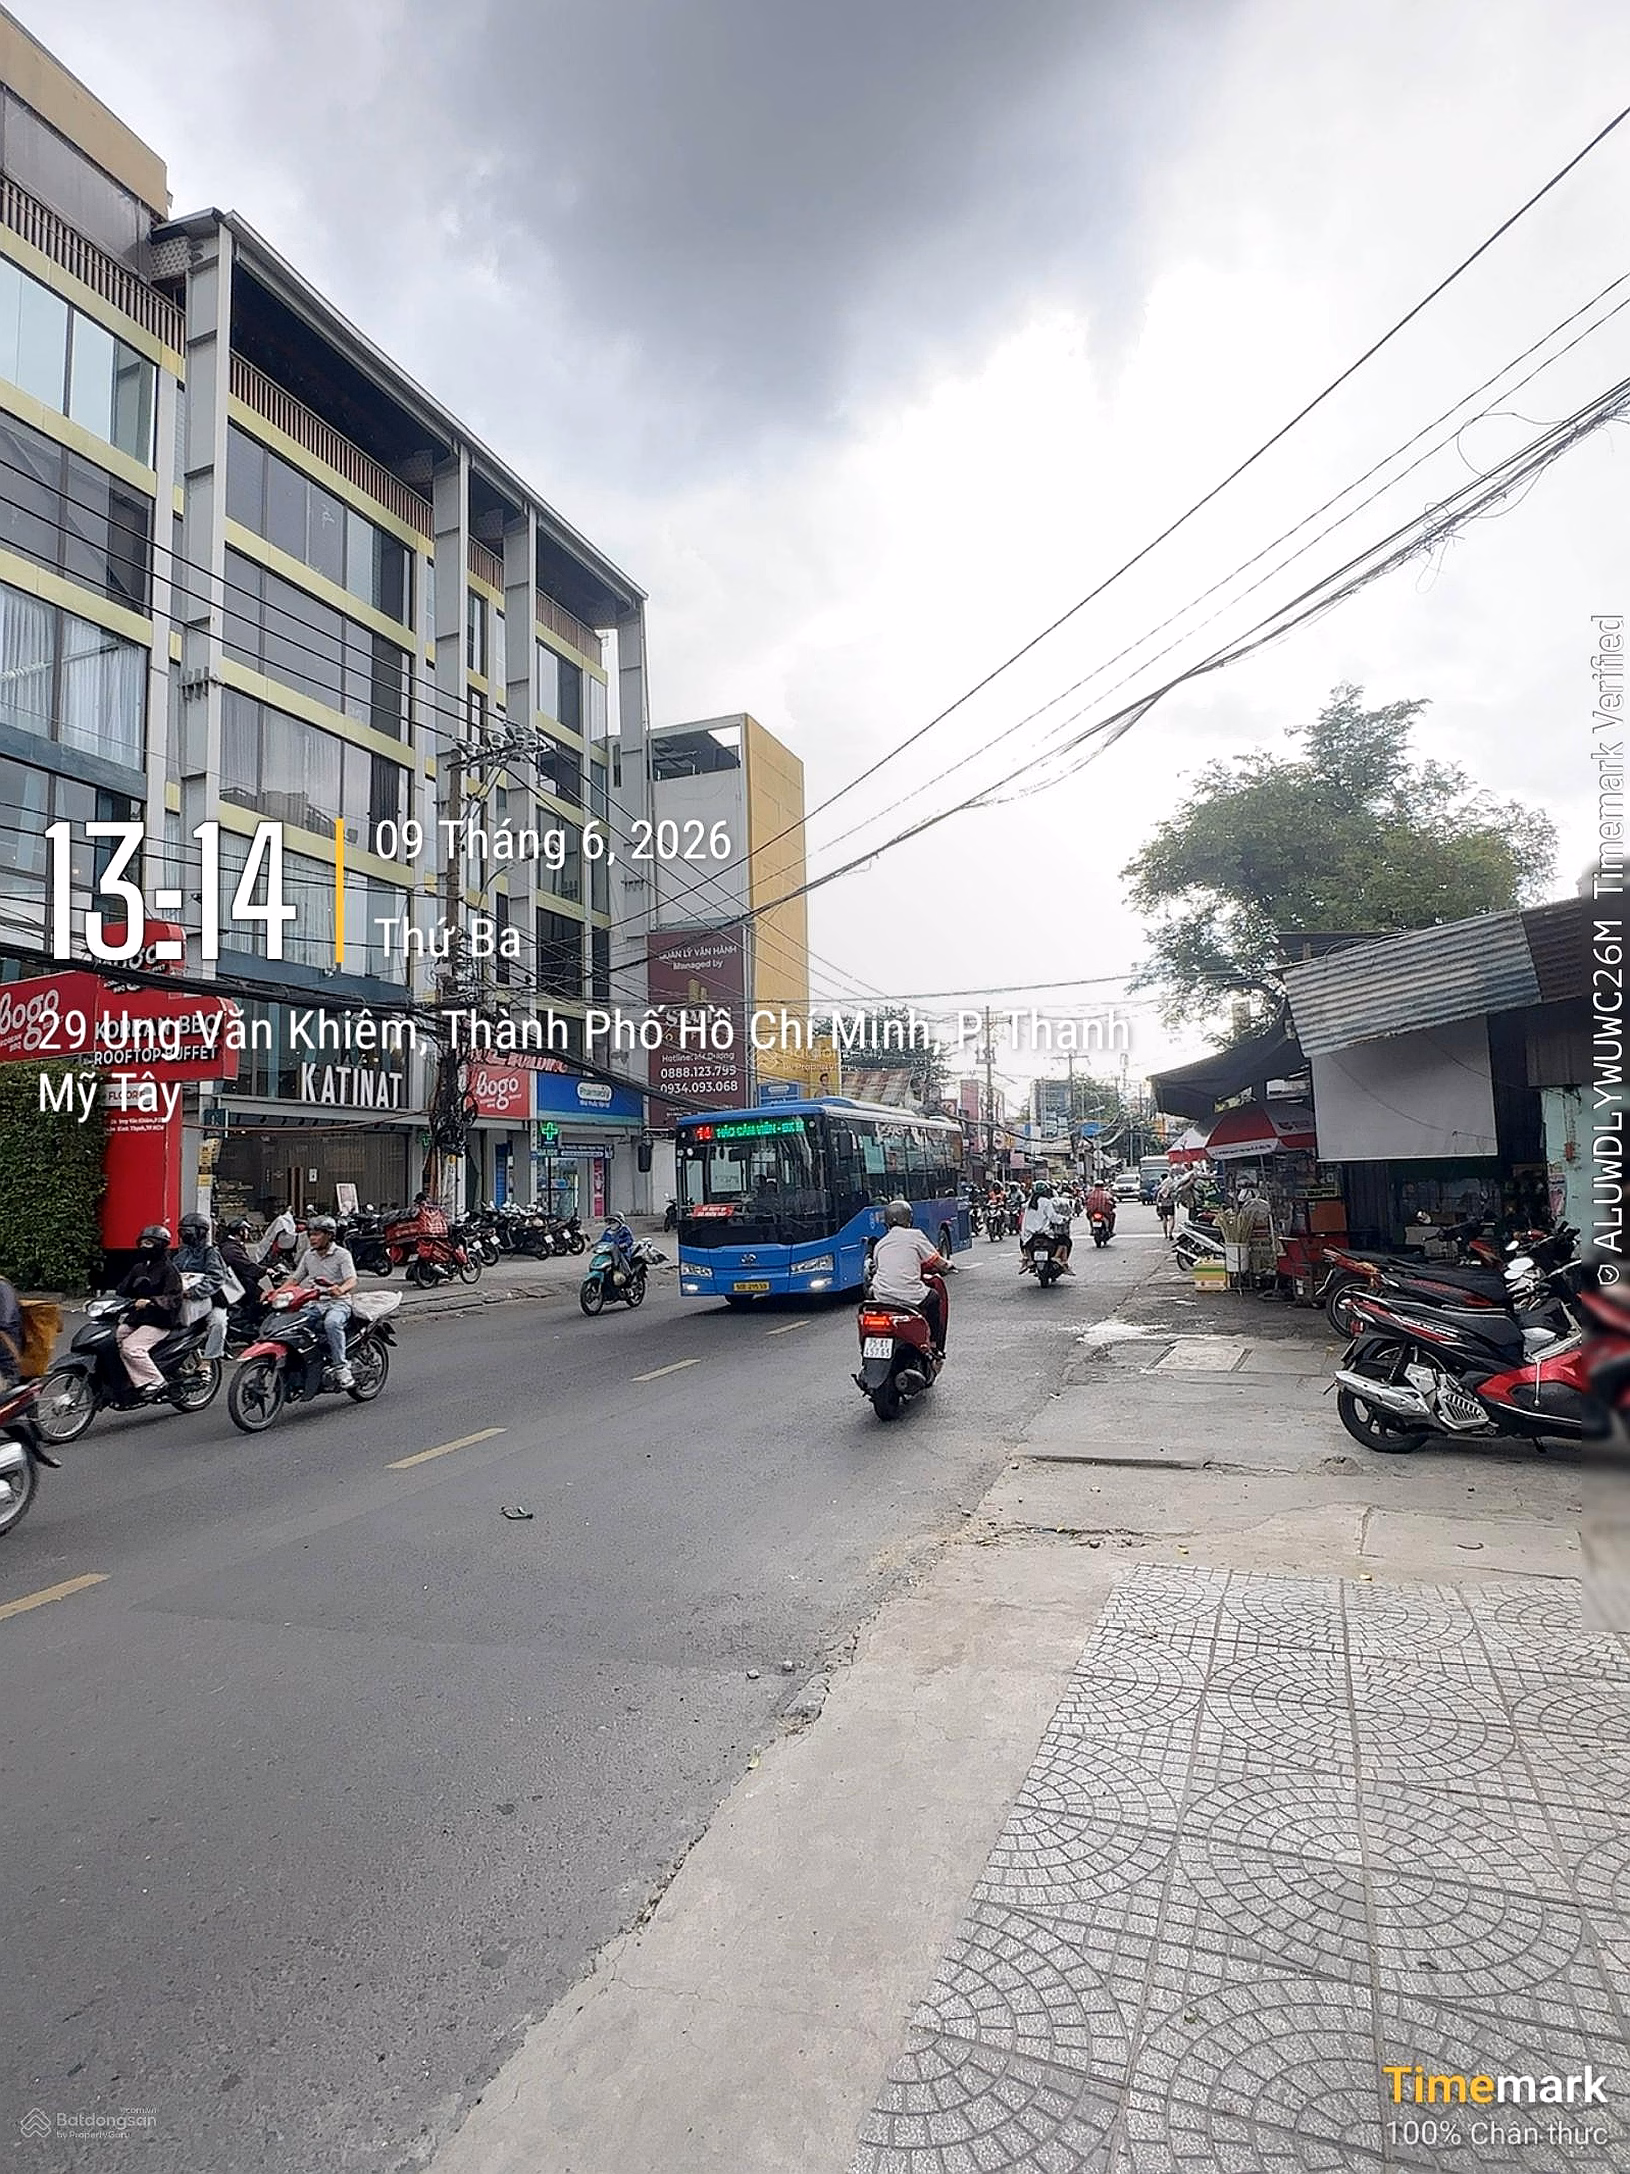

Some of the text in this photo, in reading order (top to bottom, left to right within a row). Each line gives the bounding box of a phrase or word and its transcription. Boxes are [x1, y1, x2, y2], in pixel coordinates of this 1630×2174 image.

[94, 1047, 162, 1065] ROOFTOP
[301, 1061, 403, 1109] KATINAT
[476, 1071, 519, 1110] bogo
[660, 1080, 738, 1095] 0934.093.068
